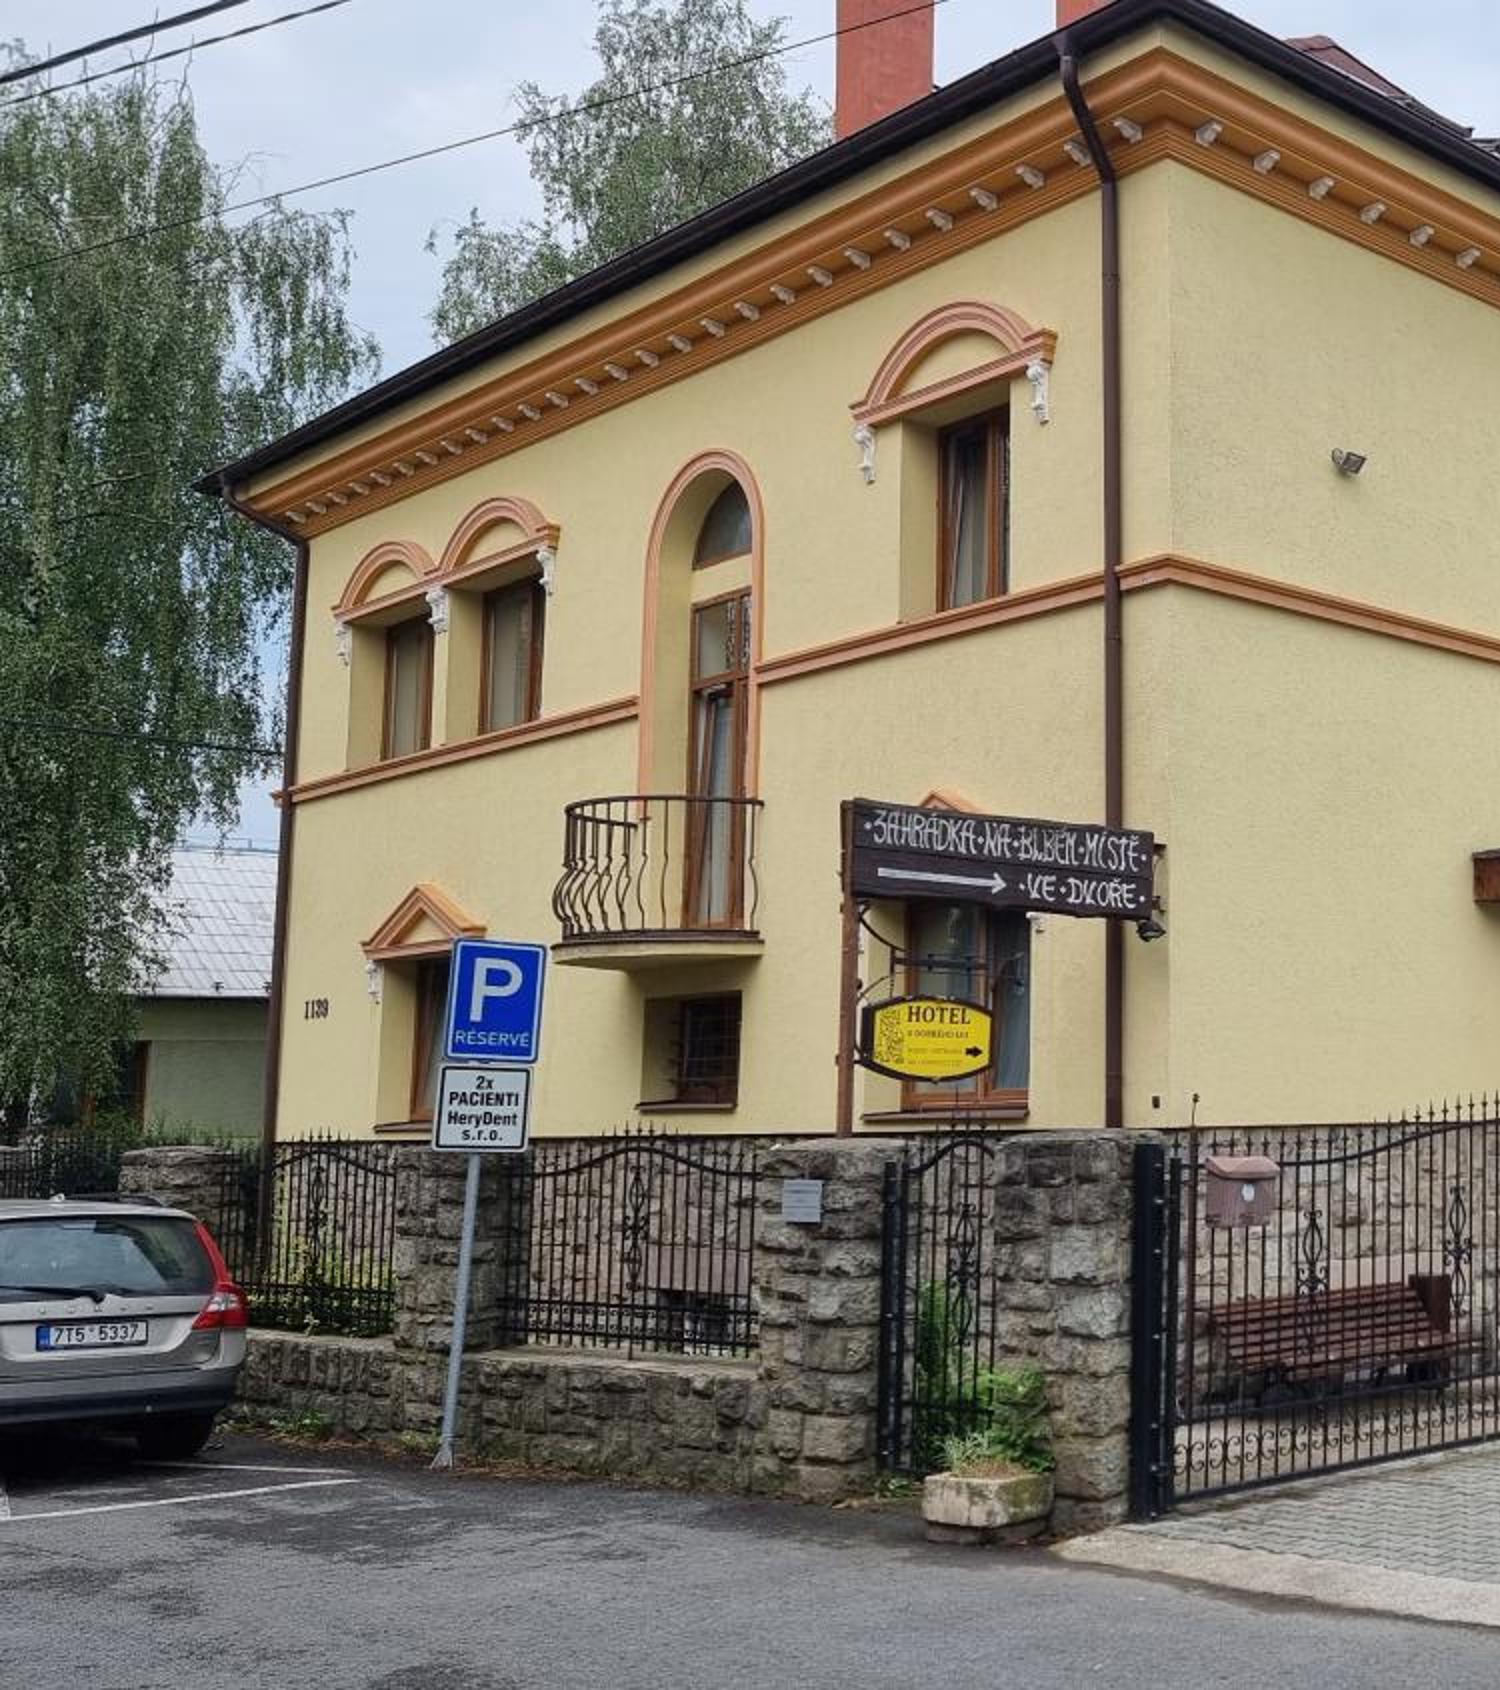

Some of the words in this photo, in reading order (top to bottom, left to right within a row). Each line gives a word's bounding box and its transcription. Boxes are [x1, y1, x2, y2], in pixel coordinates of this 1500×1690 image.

[983, 820, 1012, 859] NA
[1027, 873, 1057, 901] VE
[1066, 877, 1137, 909] DVOŘE
[469, 957, 523, 1022] P
[907, 1005, 971, 1025] HOTEL
[476, 1075, 494, 1090] 2x
[449, 1091, 519, 1107] PACIENTI
[447, 1112, 517, 1128] HeryDent
[461, 1128, 503, 1141] s.r.o.
[55, 1326, 85, 1343] 7T5
[99, 1323, 139, 1341] 5337
